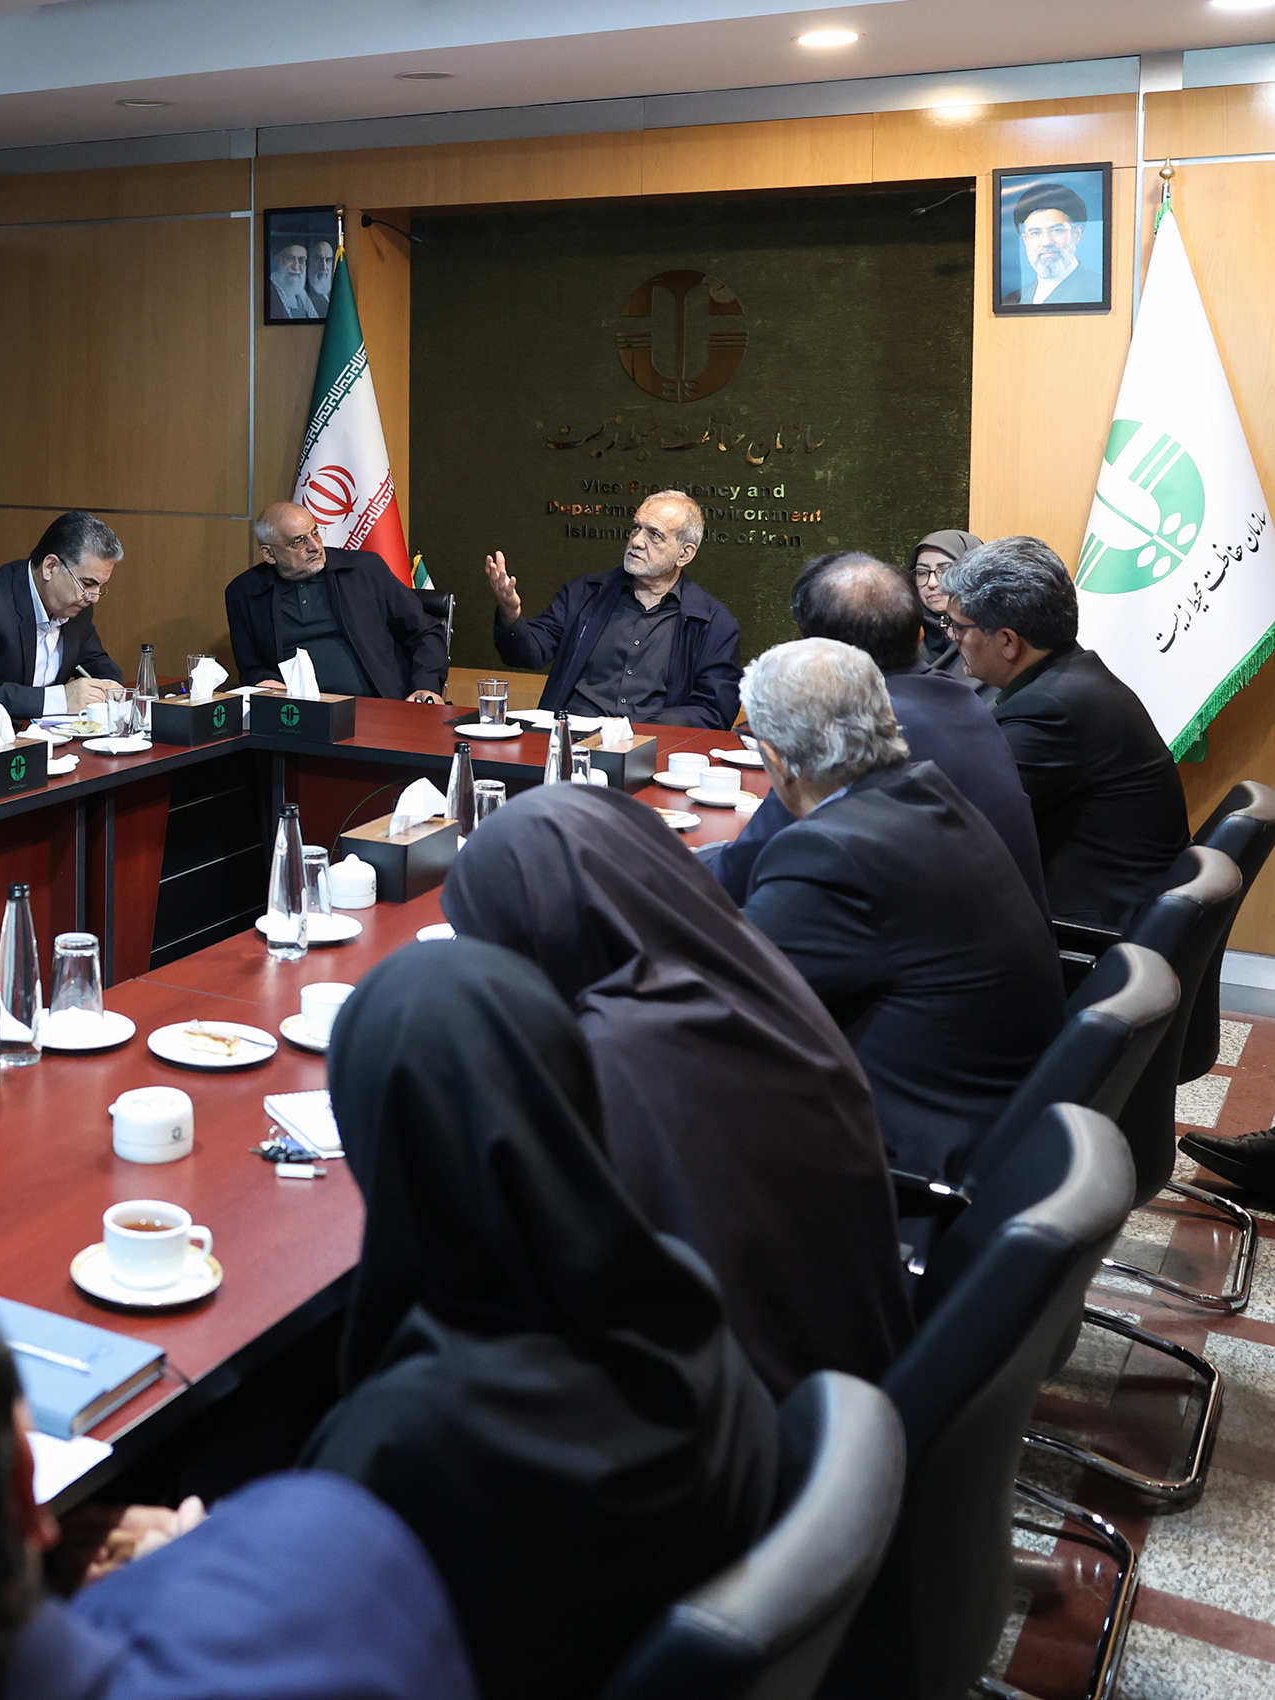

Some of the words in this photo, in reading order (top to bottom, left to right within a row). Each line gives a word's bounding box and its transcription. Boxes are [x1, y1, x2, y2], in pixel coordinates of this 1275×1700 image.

[582, 478, 623, 494] Vice
[747, 483, 785, 499] and
[546, 500, 639, 517] Departme
[701, 504, 823, 523] nvironment
[736, 529, 756, 544] of
[761, 530, 802, 547] Iran
